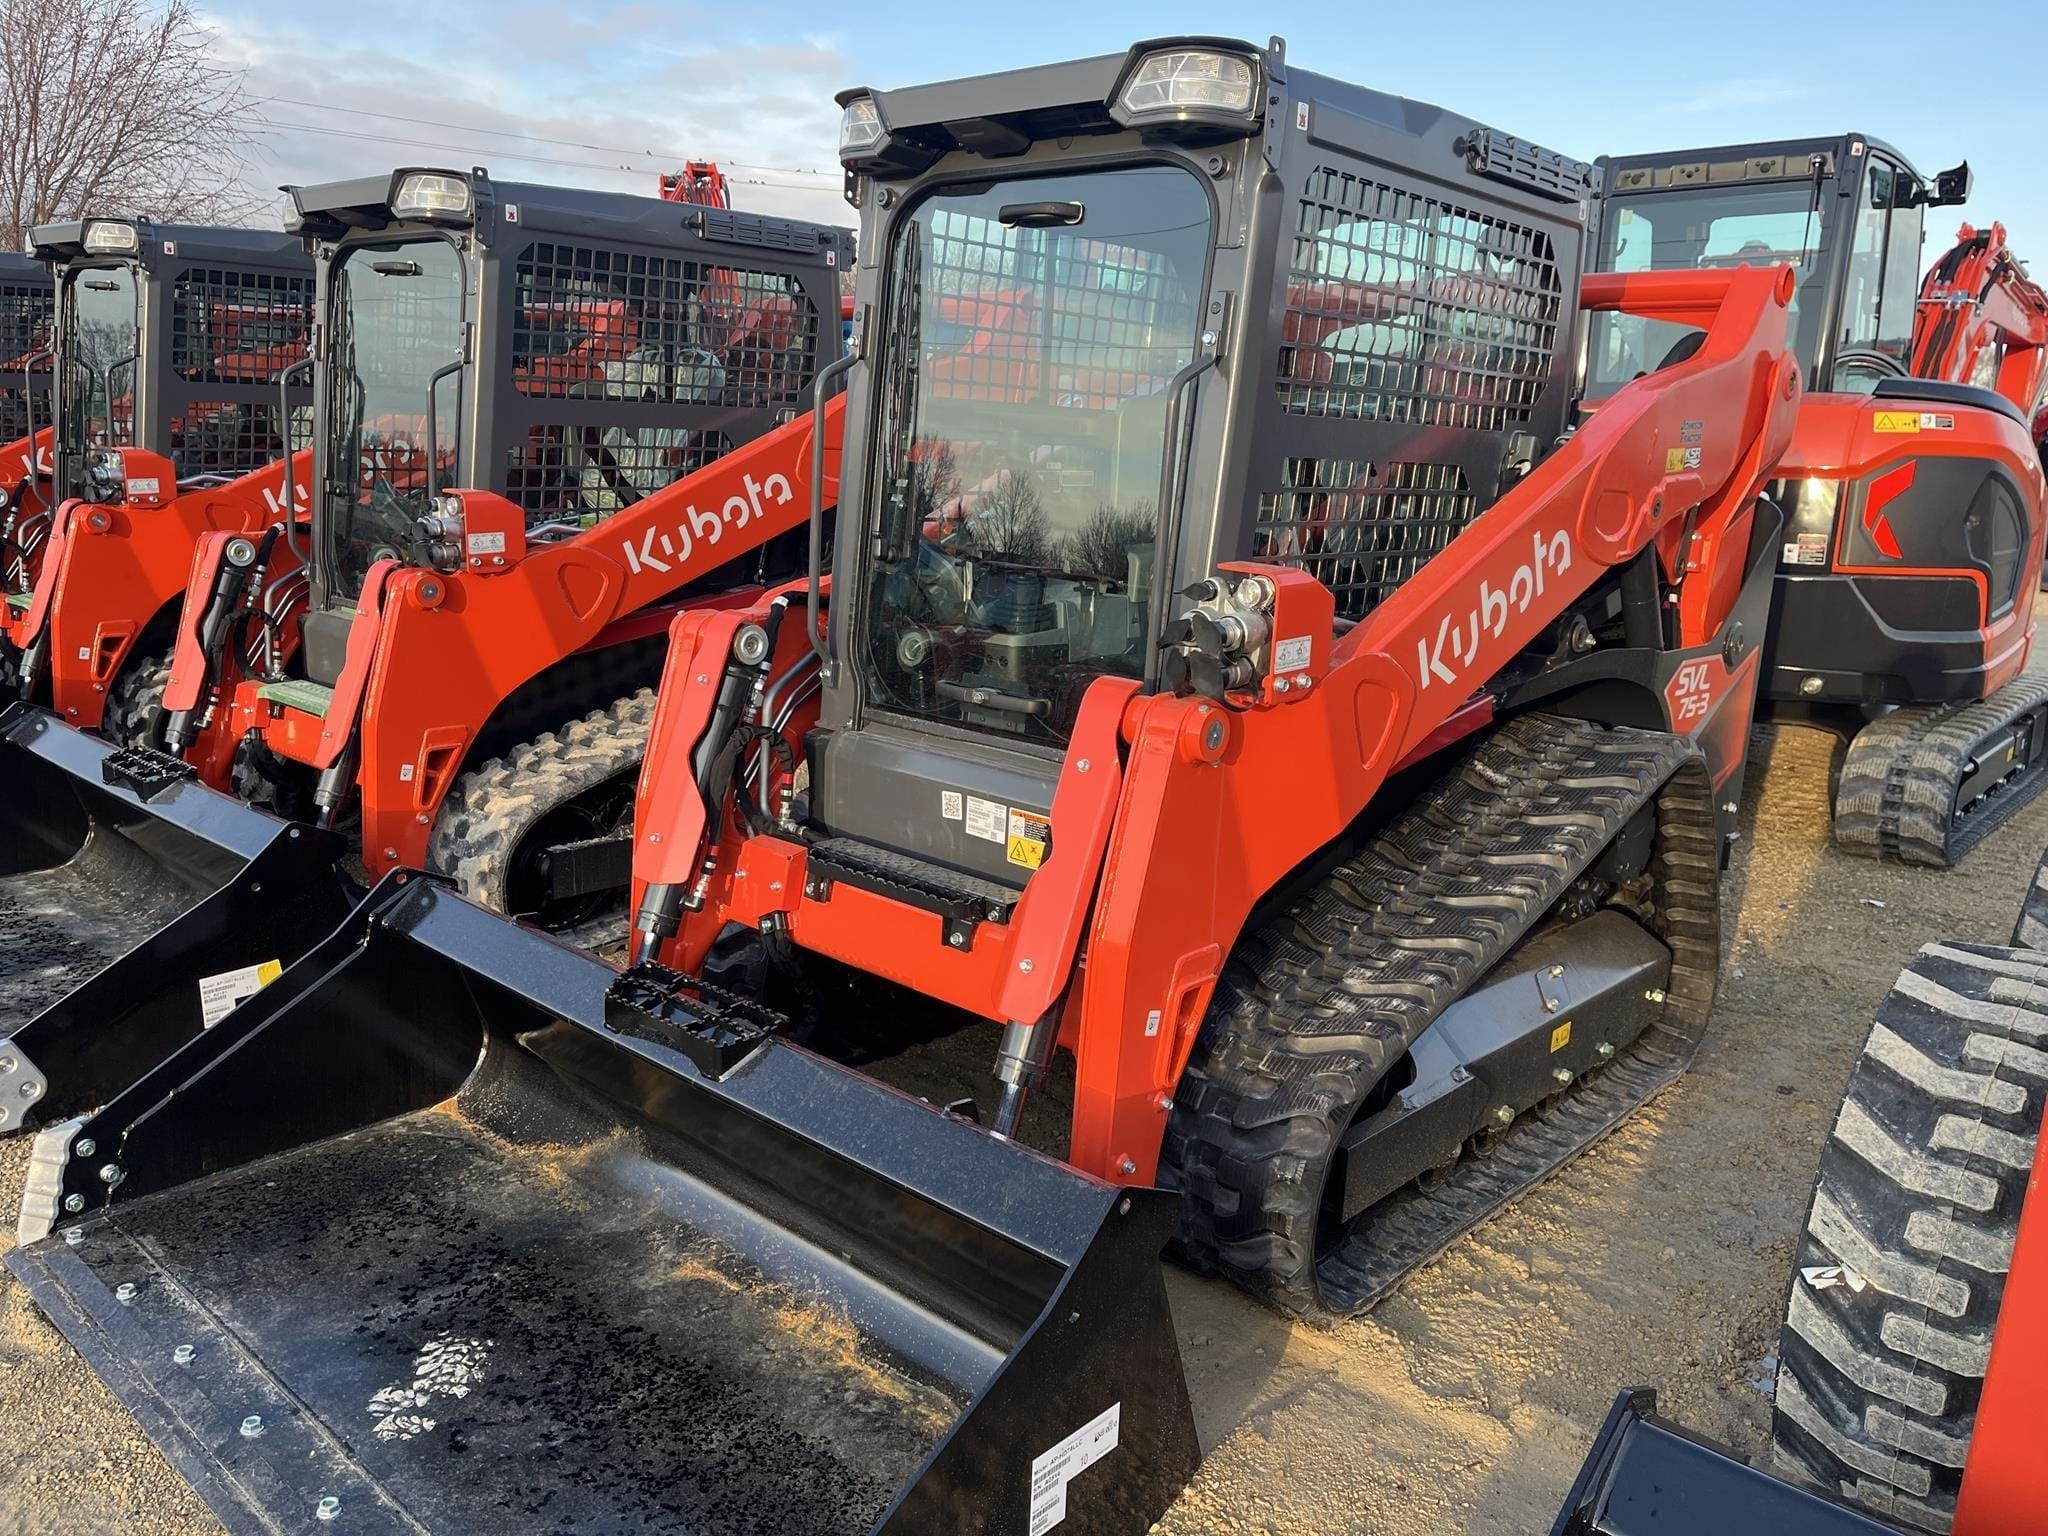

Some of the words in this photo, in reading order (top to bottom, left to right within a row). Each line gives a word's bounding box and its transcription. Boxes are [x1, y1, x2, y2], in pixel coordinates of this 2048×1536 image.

[622, 473, 793, 574] Kubota
[1417, 529, 1572, 690] Kubota
[1674, 664, 1710, 696] SVL
[1678, 692, 1710, 720] 75-3
